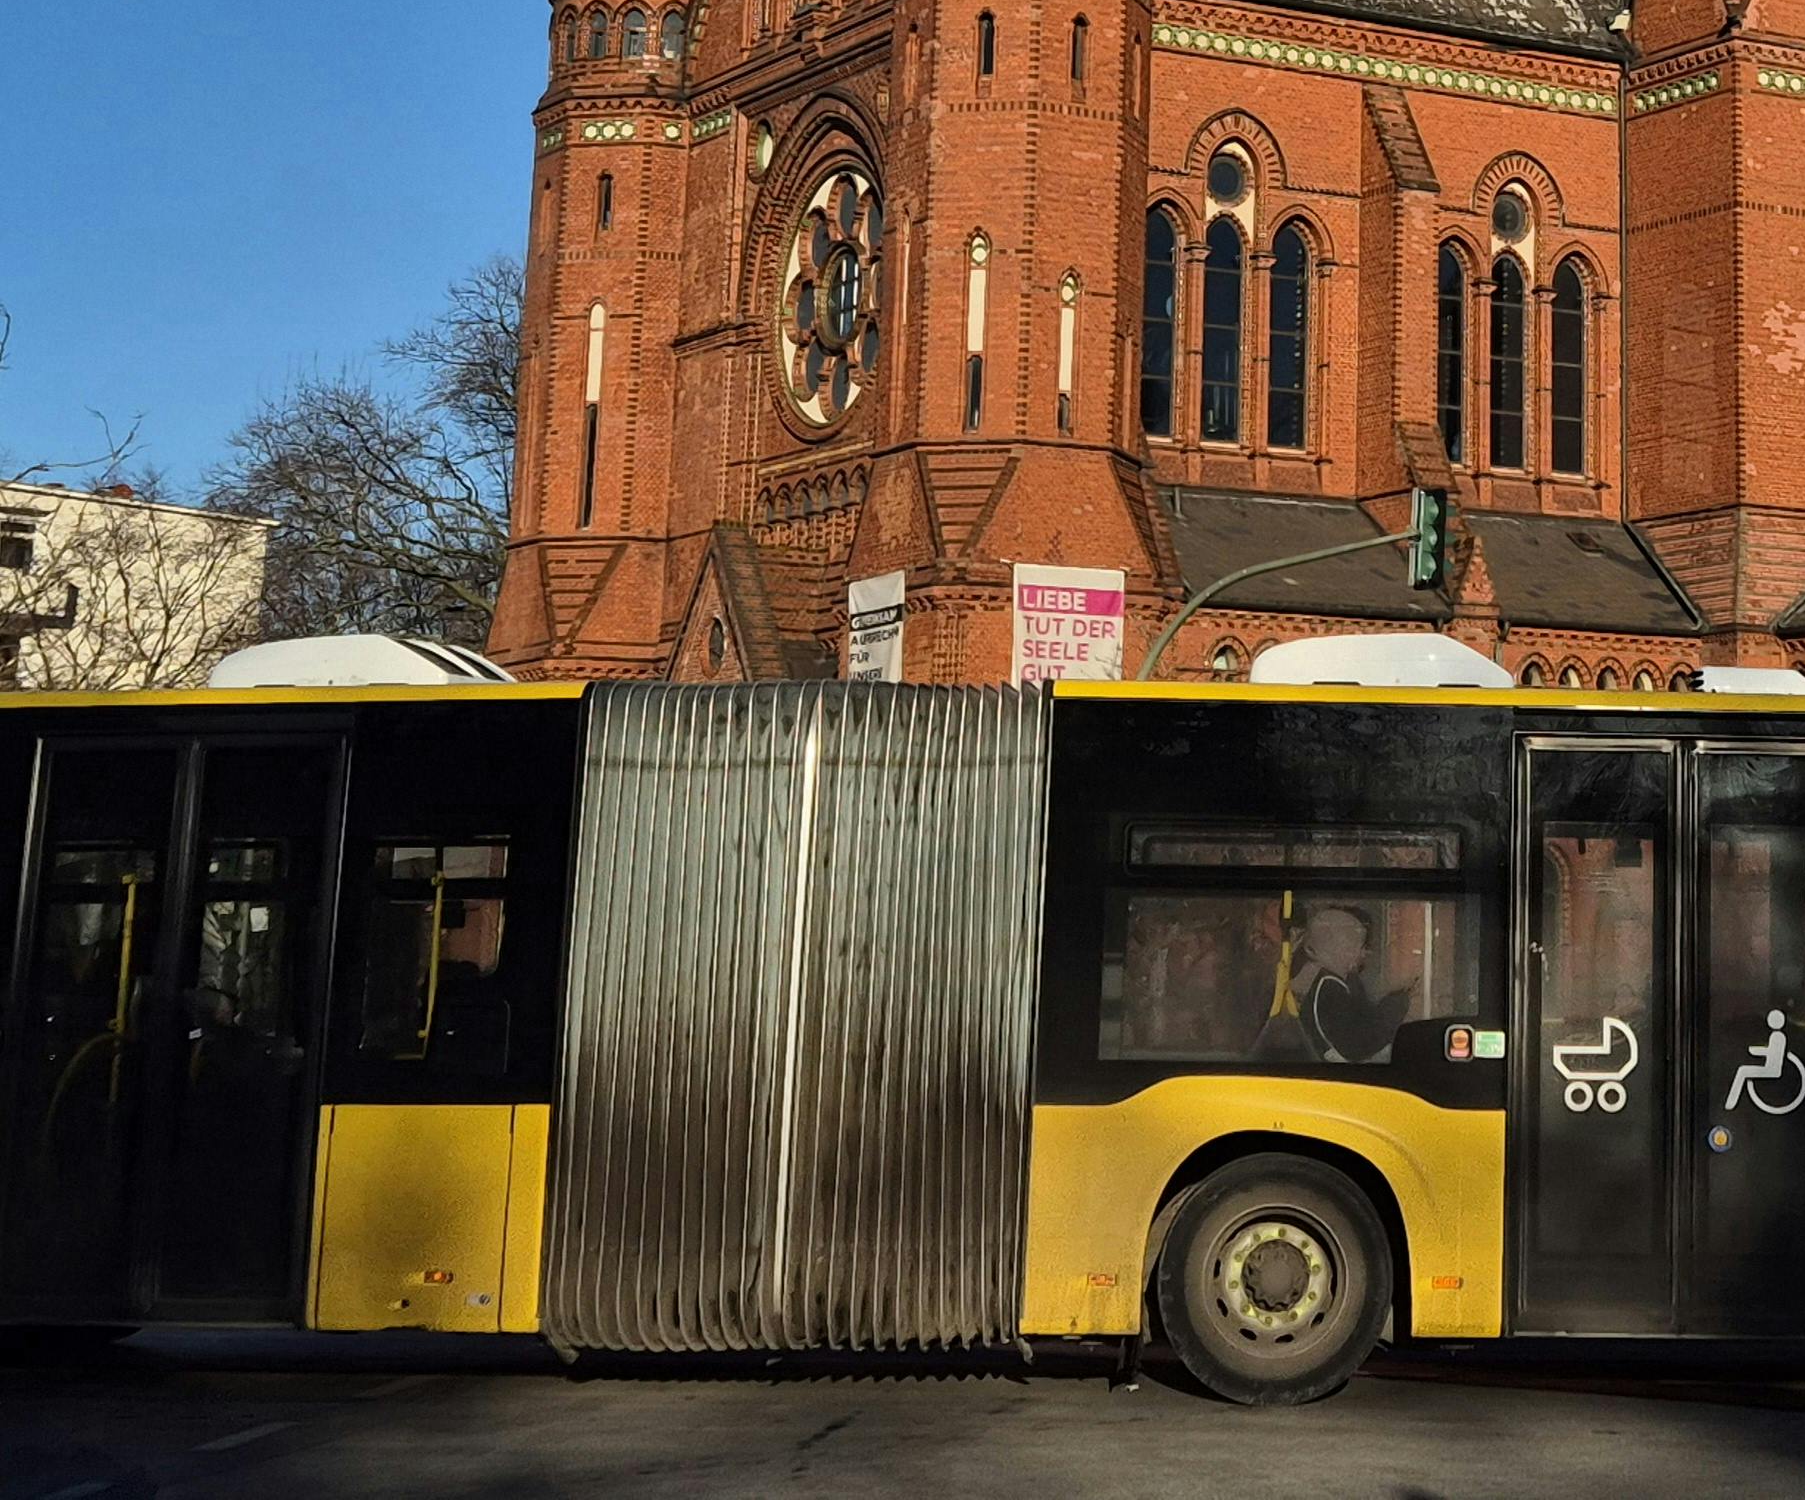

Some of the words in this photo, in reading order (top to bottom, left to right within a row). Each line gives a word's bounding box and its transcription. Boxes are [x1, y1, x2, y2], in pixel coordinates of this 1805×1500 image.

[1023, 588, 1087, 611] LIEBE
[1023, 615, 1065, 636] TUT
[1072, 619, 1115, 638] DER
[1023, 639, 1089, 661] SEELE
[1022, 664, 1066, 681] GUT
